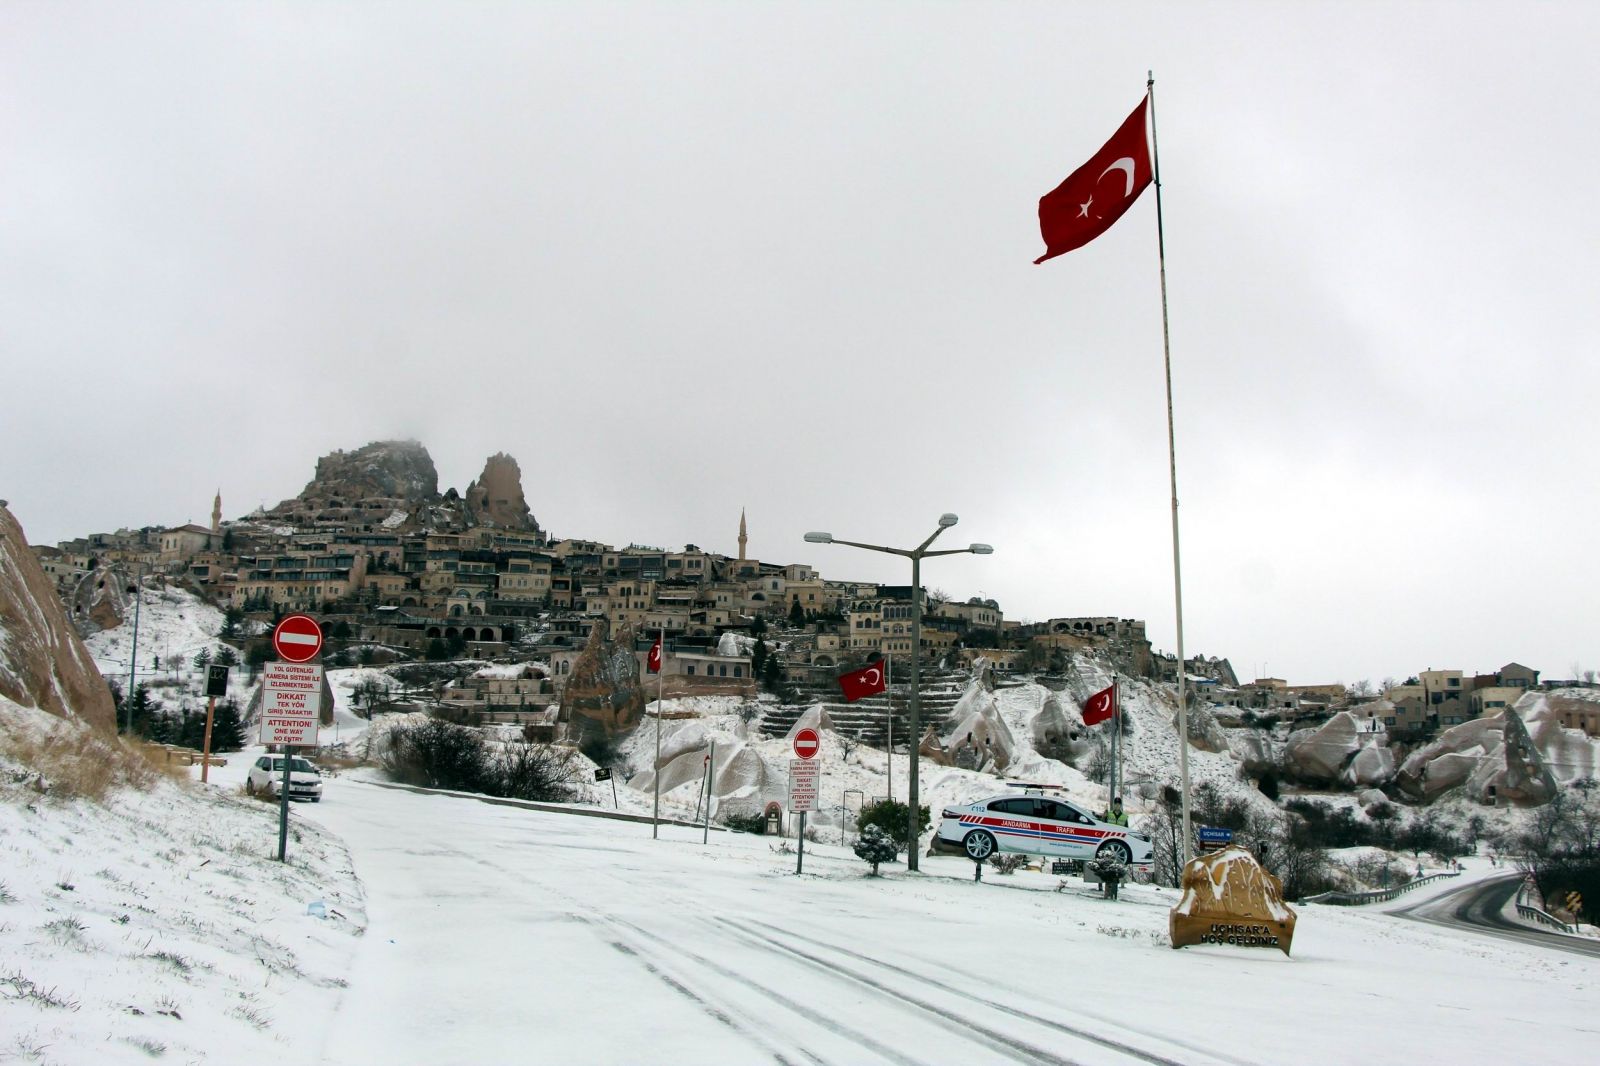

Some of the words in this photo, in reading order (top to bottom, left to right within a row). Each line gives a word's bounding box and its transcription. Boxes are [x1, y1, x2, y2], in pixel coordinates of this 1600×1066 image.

[268, 719, 312, 728] ATTENTION!
[1001, 820, 1031, 829] JANDARMA
[1200, 934, 1224, 946] HOŞ
